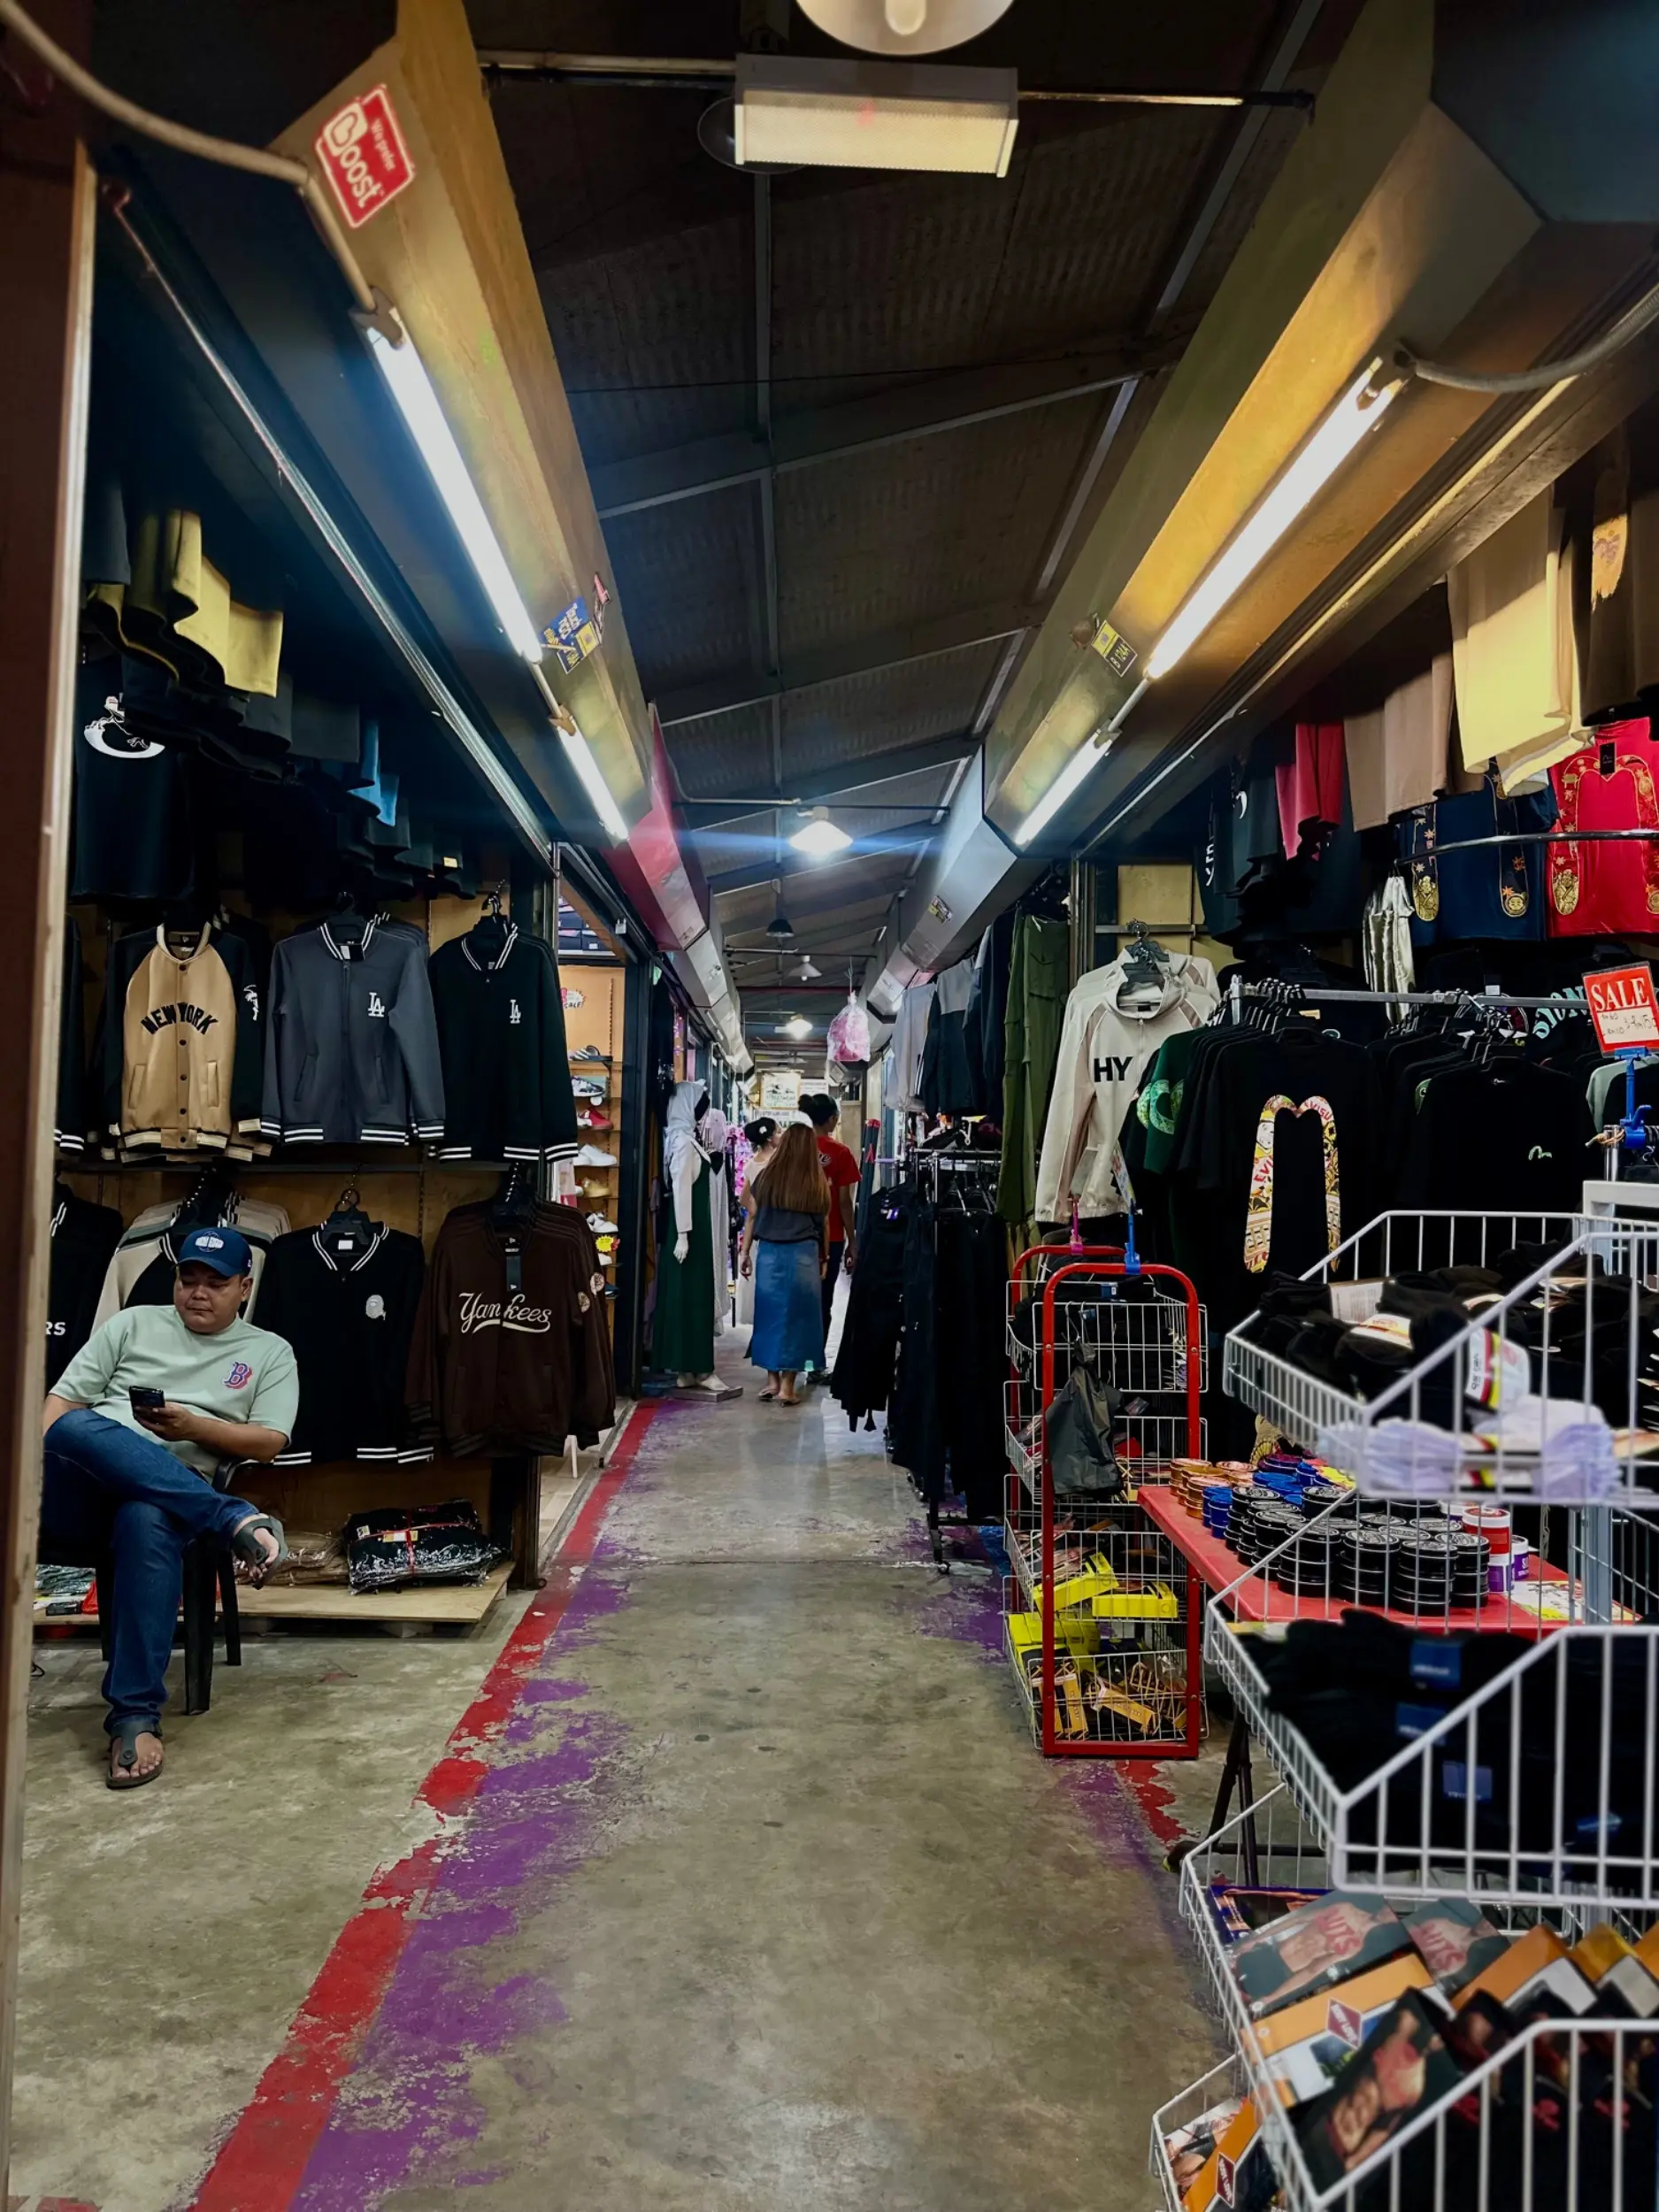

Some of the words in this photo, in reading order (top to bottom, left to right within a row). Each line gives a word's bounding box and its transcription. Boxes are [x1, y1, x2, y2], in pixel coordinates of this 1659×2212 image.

[323, 103, 381, 208] Boost
[368, 992, 386, 1017] LA
[1591, 978, 1650, 1011] SALE
[141, 1004, 176, 1034] NEW
[177, 1002, 219, 1034] YORK
[510, 1000, 521, 1024] LA
[1094, 1056, 1133, 1082] HY
[458, 1292, 552, 1333] Yankees
[222, 1361, 253, 1389] B
